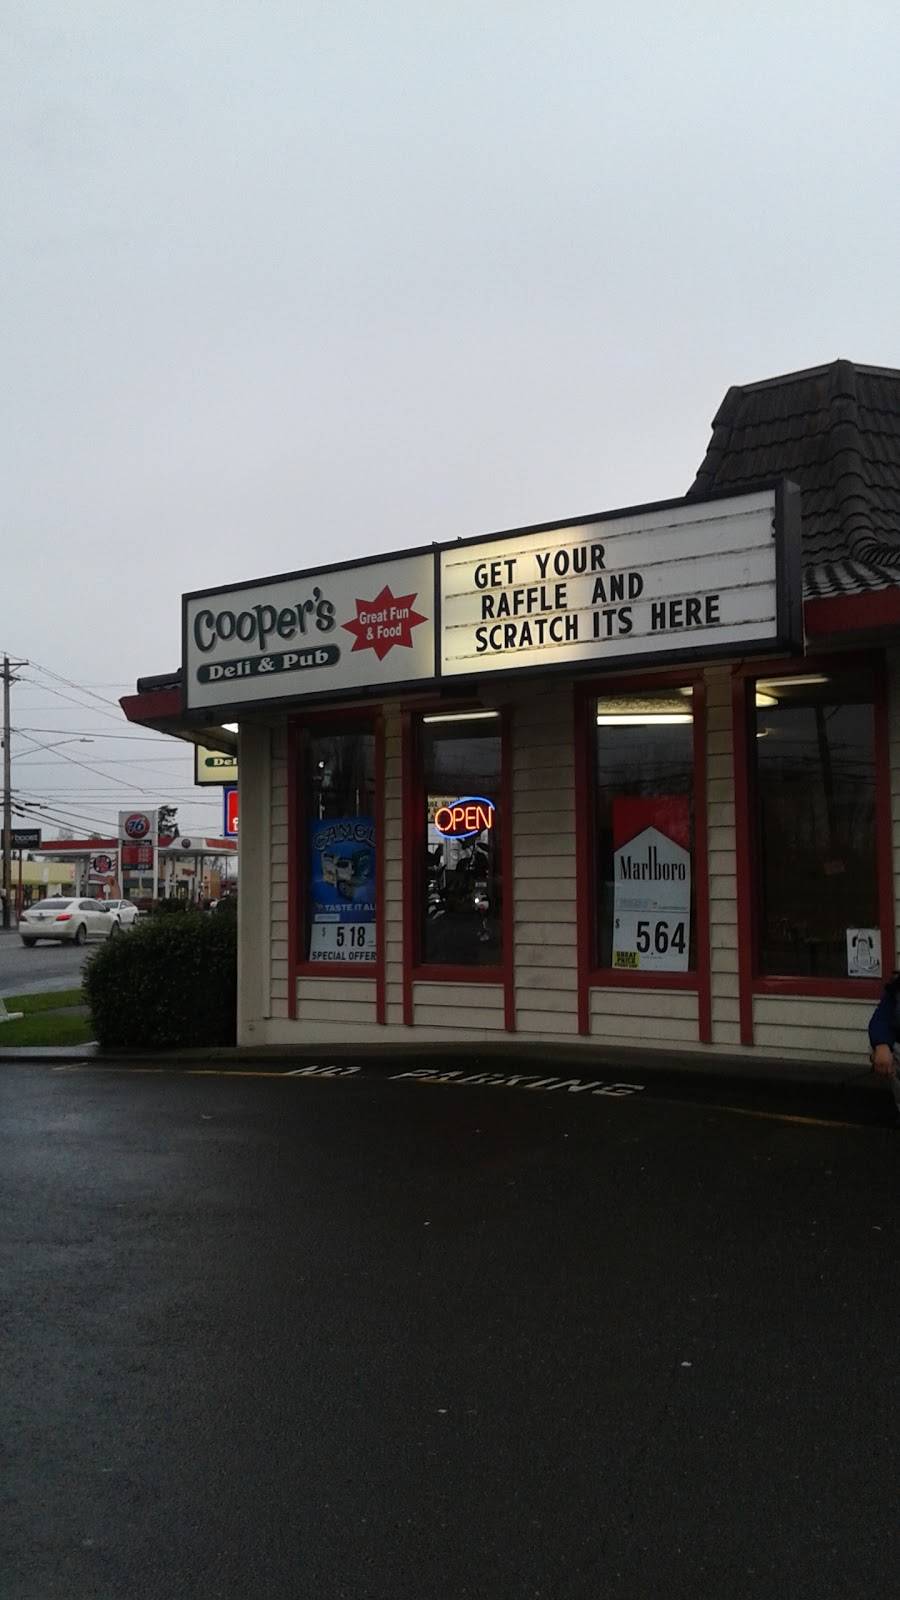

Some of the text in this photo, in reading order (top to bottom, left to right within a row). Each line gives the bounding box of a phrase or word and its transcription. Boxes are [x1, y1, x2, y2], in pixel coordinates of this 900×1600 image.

[475, 544, 606, 589] GET YOUR
[481, 572, 643, 619] RAFFLE AND
[193, 586, 335, 652] Cooper's
[359, 607, 409, 625] Great Fun
[476, 595, 720, 652] SCRATCH ITS HERE
[366, 624, 402, 641] & Food
[208, 650, 329, 681] Deli & Pub
[213, 757, 238, 766] Del
[128, 819, 145, 833] 76
[434, 806, 492, 832] OPEN
[312, 823, 377, 851] CAMEL
[620, 846, 686, 881] Marlboro
[324, 903, 353, 912] TASTE
[354, 903, 363, 912] IT
[636, 920, 686, 955] 5.64
[312, 951, 377, 961] SPECIAL OFFER
[389, 1069, 645, 1096] PARKING
